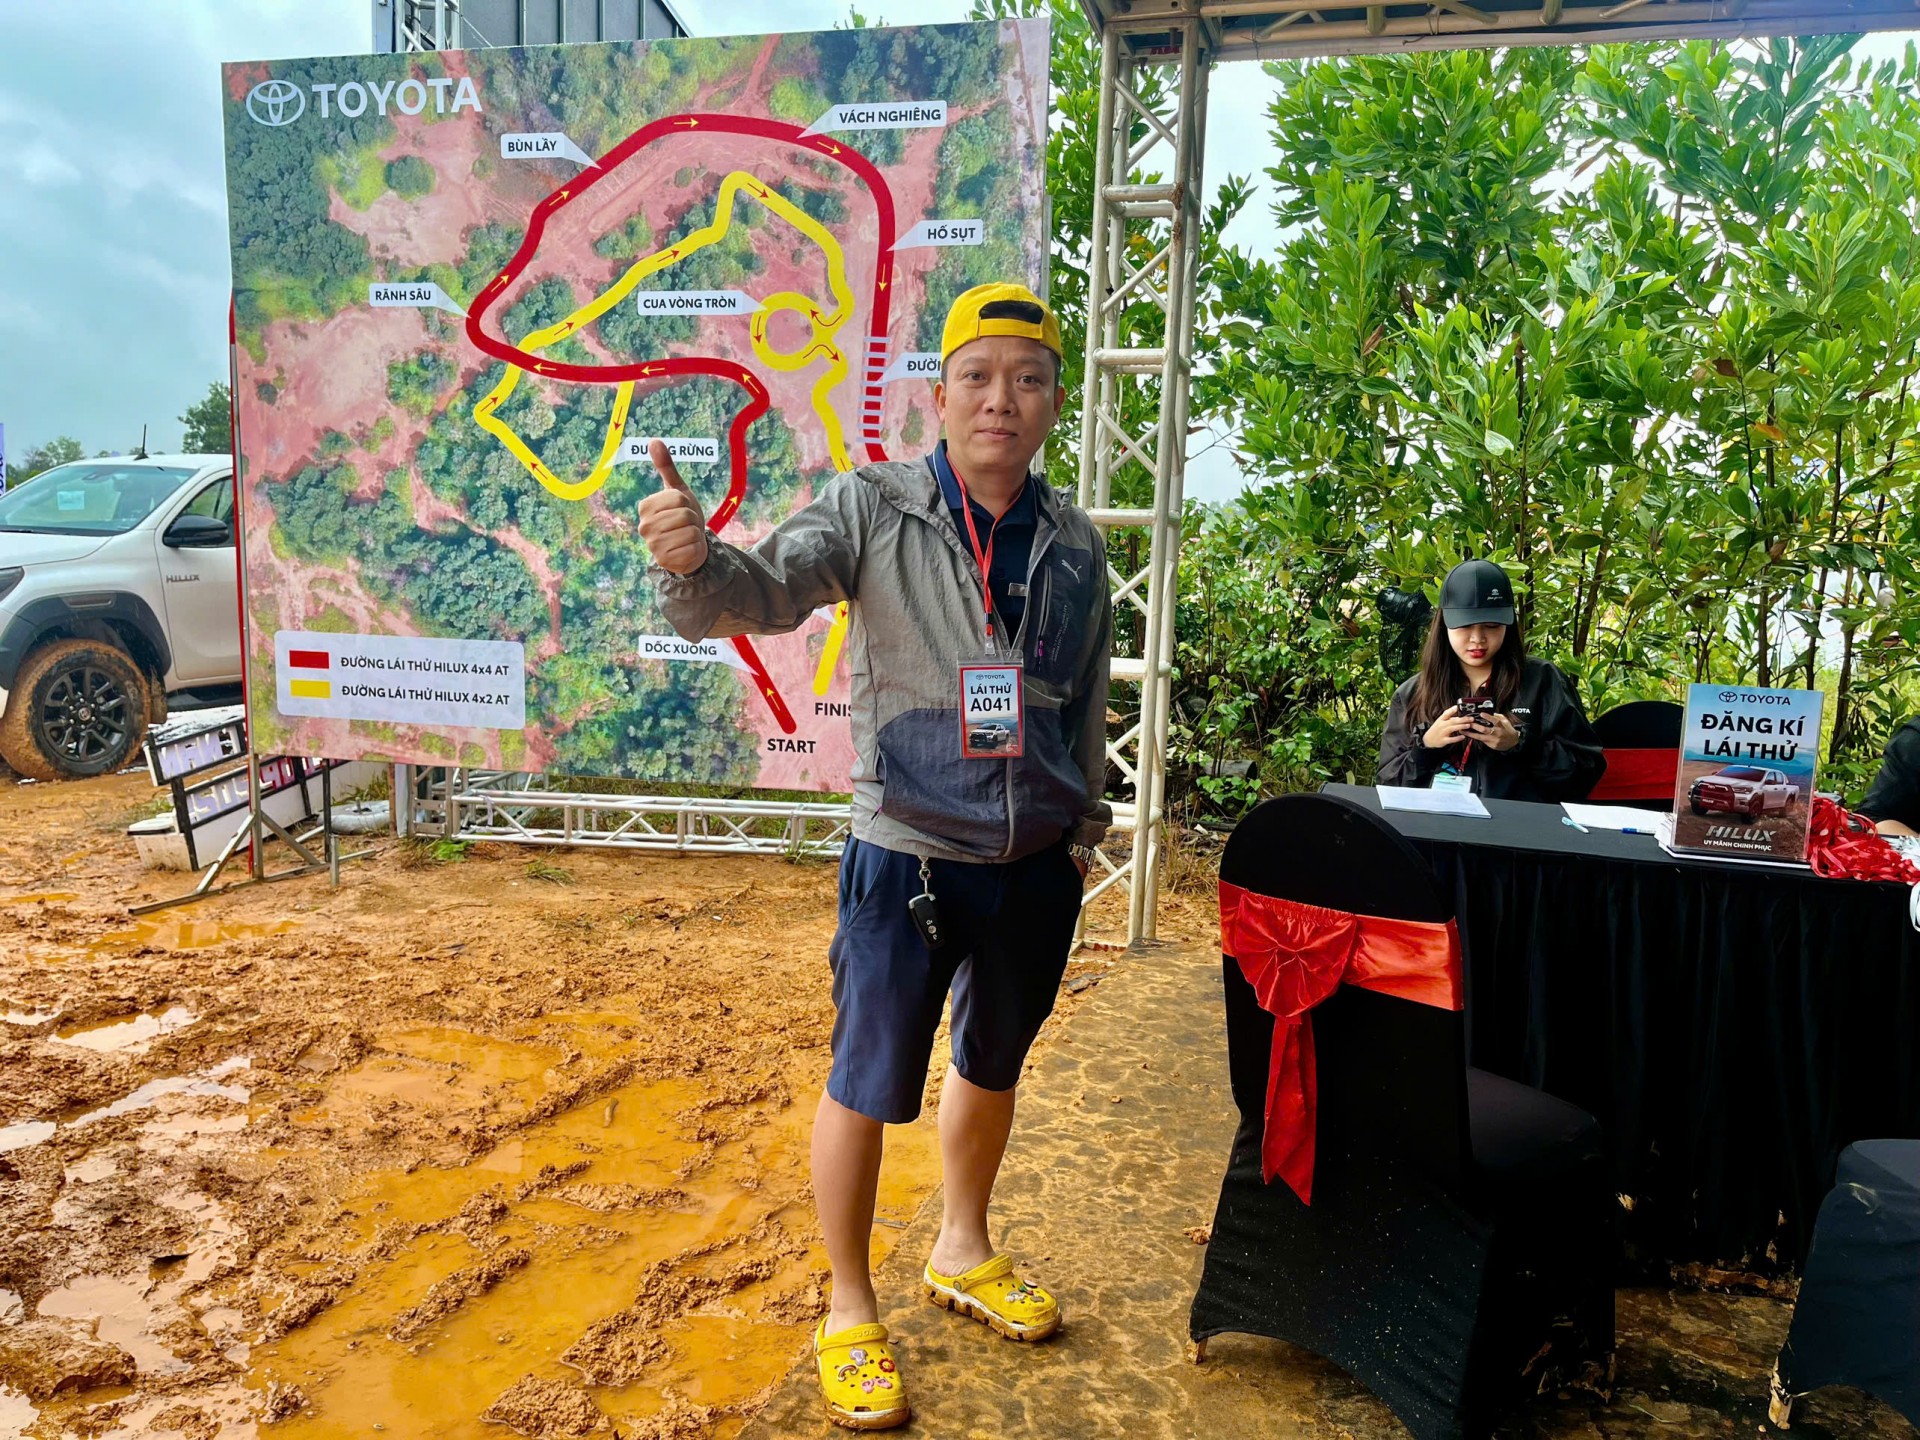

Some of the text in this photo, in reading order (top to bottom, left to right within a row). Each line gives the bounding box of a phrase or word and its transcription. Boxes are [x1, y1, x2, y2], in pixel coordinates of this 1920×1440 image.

[311, 76, 483, 118] TOYOTA
[839, 107, 941, 124] VÁCH NGHIÊNG
[508, 137, 557, 152] BÙN LẦY
[927, 224, 976, 242] HỐ SỤT
[375, 287, 431, 301] RÃNH SÂU
[643, 295, 736, 309] CUA VÒNG TRÒN
[679, 443, 714, 456] RỪNG
[166, 574, 200, 584] HILUX
[645, 640, 671, 653] DỐC
[341, 655, 510, 676] ĐƯỜNG LÁI THỬ HILUX 4x4 AT
[342, 684, 510, 705] ĐƯỜNG LÁI THỬ HILUX 4x2 AT
[970, 682, 1012, 695] LÁI THỬ
[970, 698, 1011, 712] A041
[1740, 693, 1791, 706] TOYOTA
[815, 702, 851, 717] FINI
[1700, 710, 1807, 736] ĐĂNG KÍ
[767, 738, 816, 754] START
[1703, 736, 1799, 762] LÁI THỬ
[1705, 825, 1777, 842] HILUX
